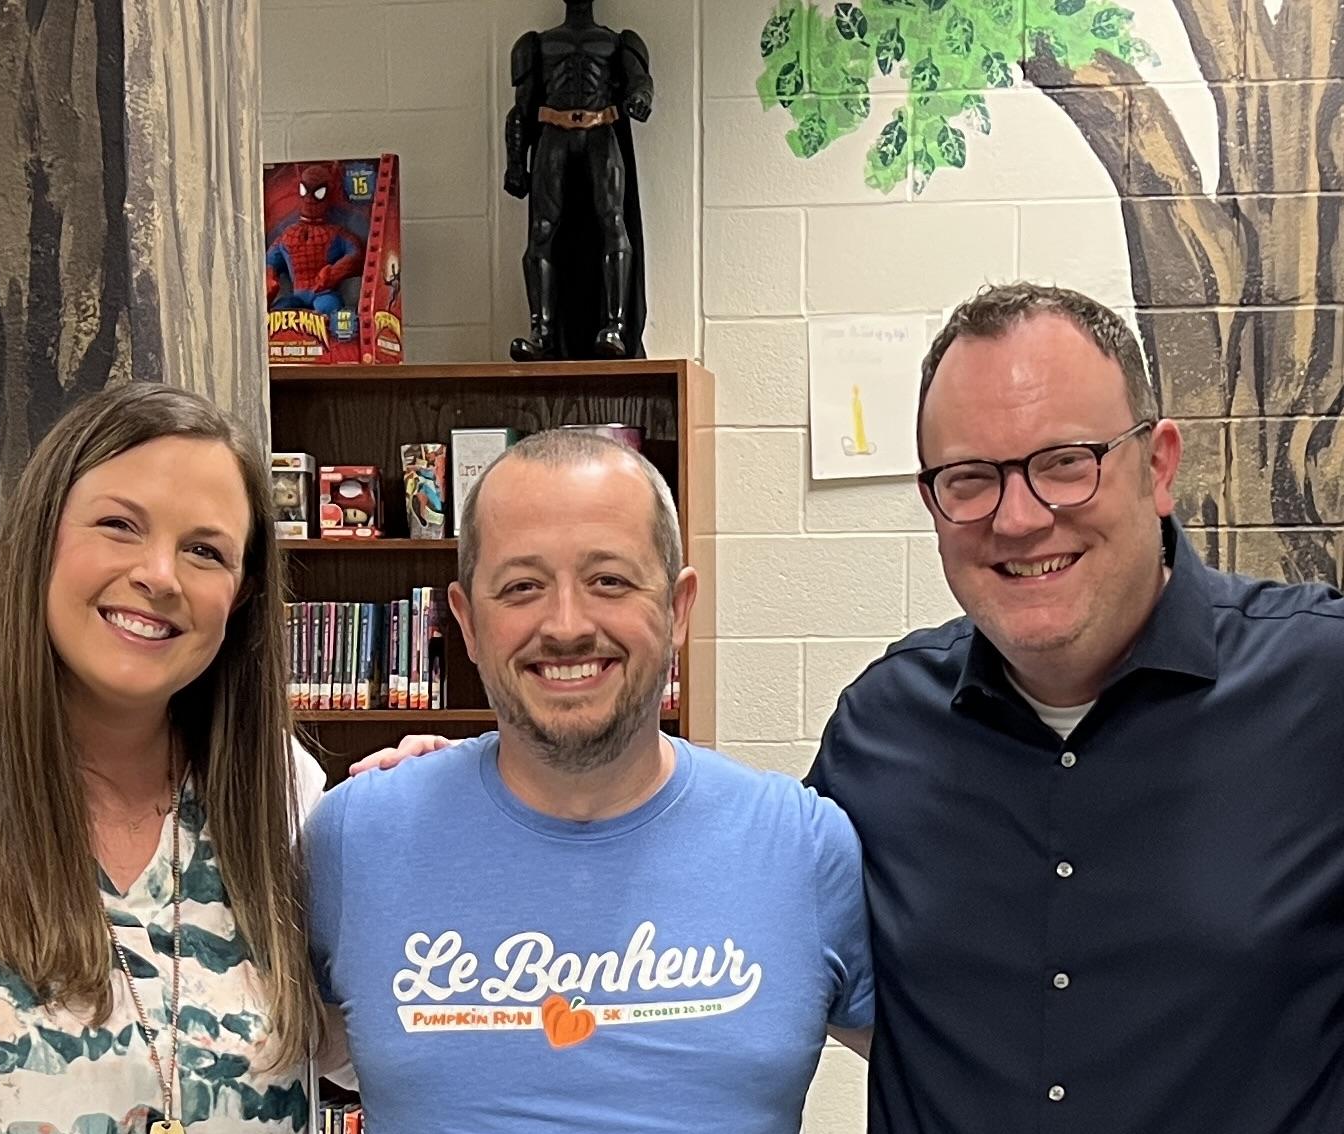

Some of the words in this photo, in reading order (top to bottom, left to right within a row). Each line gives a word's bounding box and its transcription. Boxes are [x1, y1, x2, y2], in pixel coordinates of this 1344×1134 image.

[352, 176, 368, 195] 15
[266, 311, 331, 353] PIDER-MAN
[392, 929, 479, 1001] Le
[480, 920, 763, 1003] Bonheur
[493, 1010, 532, 1025] RUN
[602, 1008, 622, 1021] 5K
[632, 1006, 680, 1018] OCTOBER
[700, 1003, 722, 1013] 2018
